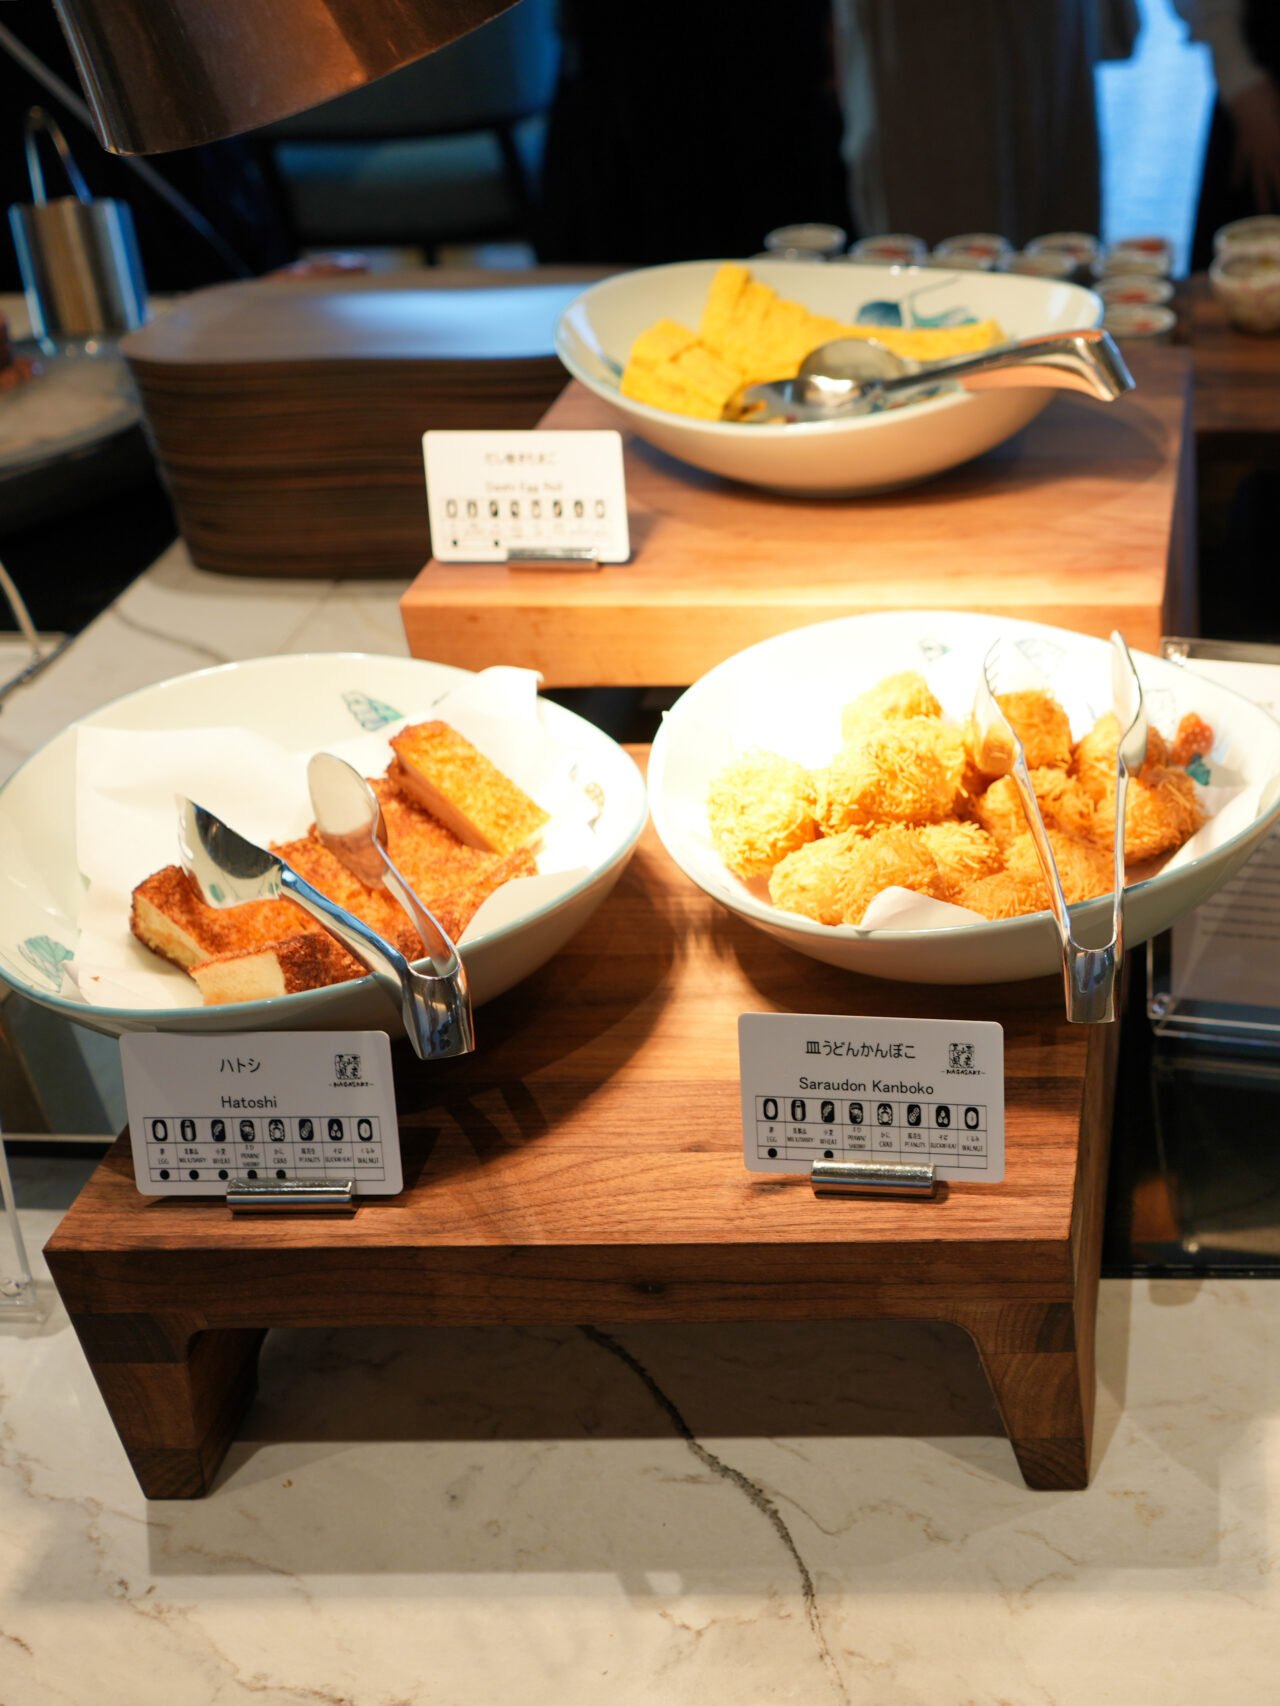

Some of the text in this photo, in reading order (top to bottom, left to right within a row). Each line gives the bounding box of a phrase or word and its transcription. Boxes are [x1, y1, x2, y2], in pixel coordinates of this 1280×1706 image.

[805, 1040, 916, 1060] 皿うどんかんぼこ
[220, 1057, 261, 1073] ハトシ
[799, 1077, 934, 1095] Saraudon Kanboko
[221, 1096, 277, 1109] Hatoshi
